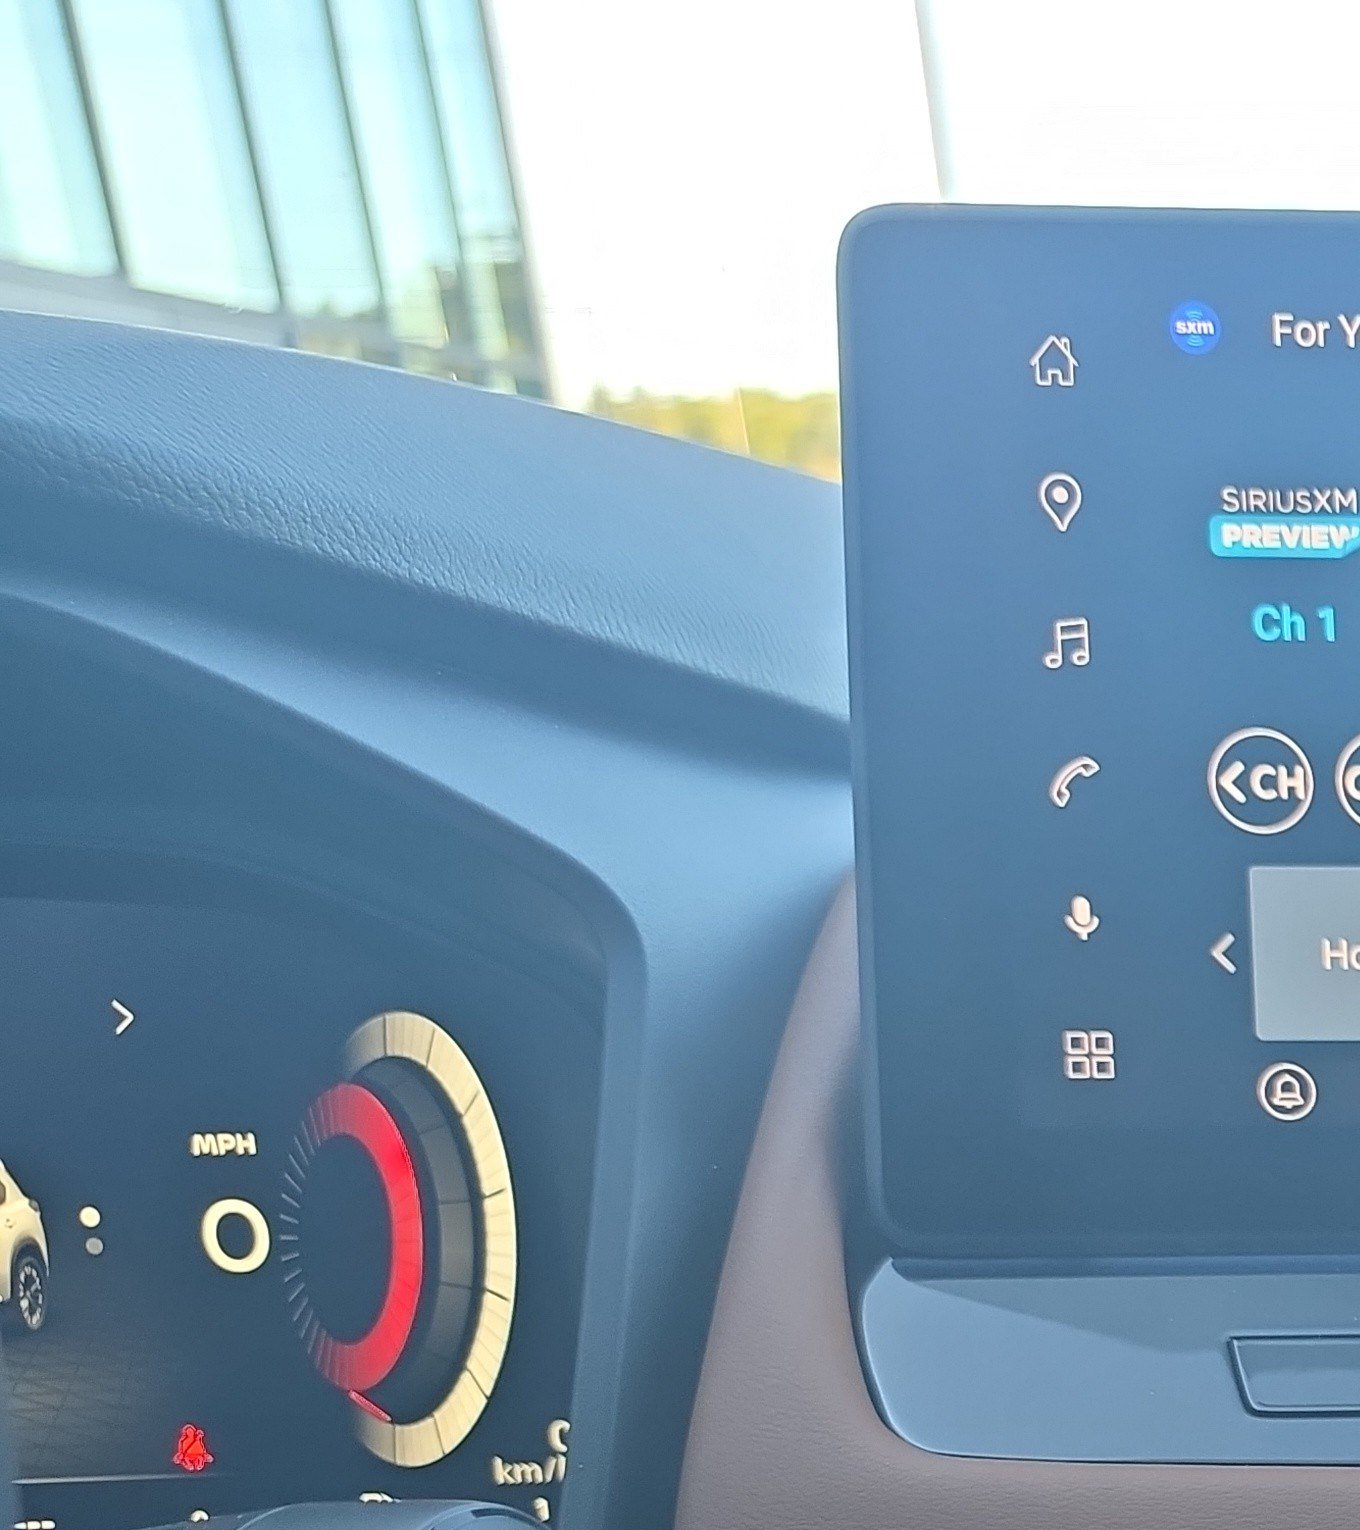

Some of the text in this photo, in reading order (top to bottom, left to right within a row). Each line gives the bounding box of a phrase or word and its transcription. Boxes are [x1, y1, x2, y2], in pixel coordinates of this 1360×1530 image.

[1175, 320, 1215, 335] sxm
[1272, 314, 1330, 348] For
[1221, 487, 1358, 515] SIRIUSXM
[1221, 524, 1360, 550] PREVIEW
[1251, 603, 1337, 643] Ch 1
[191, 1132, 257, 1158] MPH
